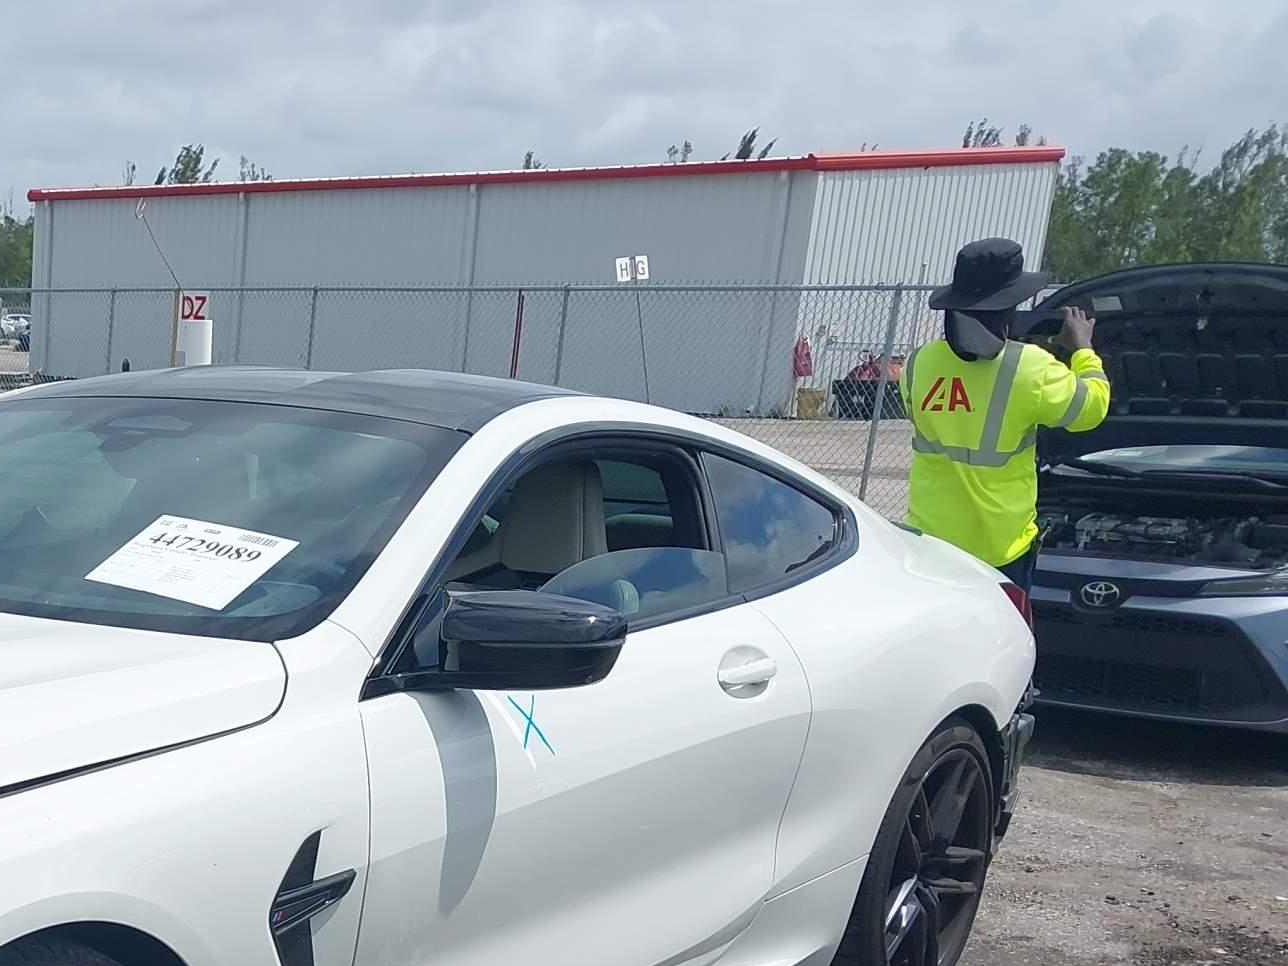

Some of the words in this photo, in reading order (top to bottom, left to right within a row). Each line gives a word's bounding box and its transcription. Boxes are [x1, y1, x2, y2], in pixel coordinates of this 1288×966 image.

[620, 262, 628, 278] H
[637, 260, 646, 275] G
[182, 295, 207, 320] DZ
[149, 532, 262, 563] 44729089
